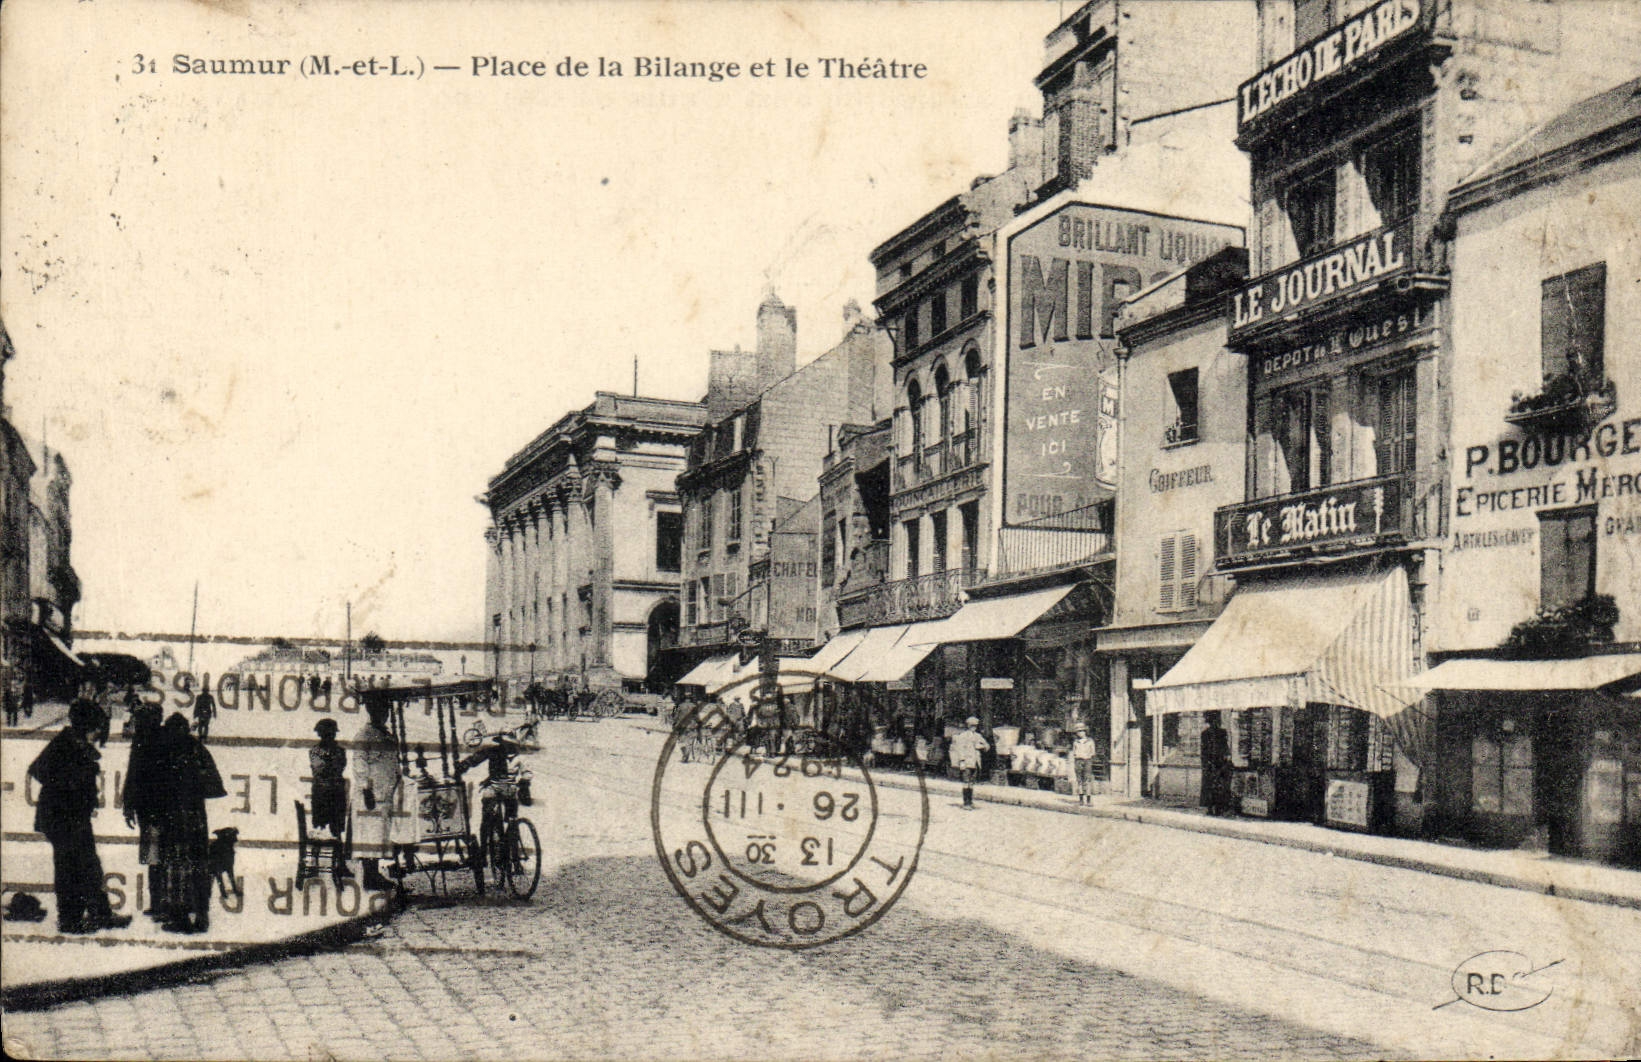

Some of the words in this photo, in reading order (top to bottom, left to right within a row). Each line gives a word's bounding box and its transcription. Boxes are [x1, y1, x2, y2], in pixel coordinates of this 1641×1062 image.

[1313, 30, 1342, 82] DE
[1343, 0, 1420, 65] PARIS
[1059, 213, 1150, 257] BRILLANT
[1019, 253, 1171, 350] MIR
[1233, 285, 1263, 329] LE
[1271, 231, 1405, 314] JOURNAL
[1042, 384, 1066, 401] EN
[1025, 409, 1081, 432] VENTE
[1041, 439, 1066, 457] ICI
[1456, 482, 1566, 517] EPICERIE
[1246, 510, 1272, 550] Le
[1279, 496, 1358, 545] Matin
